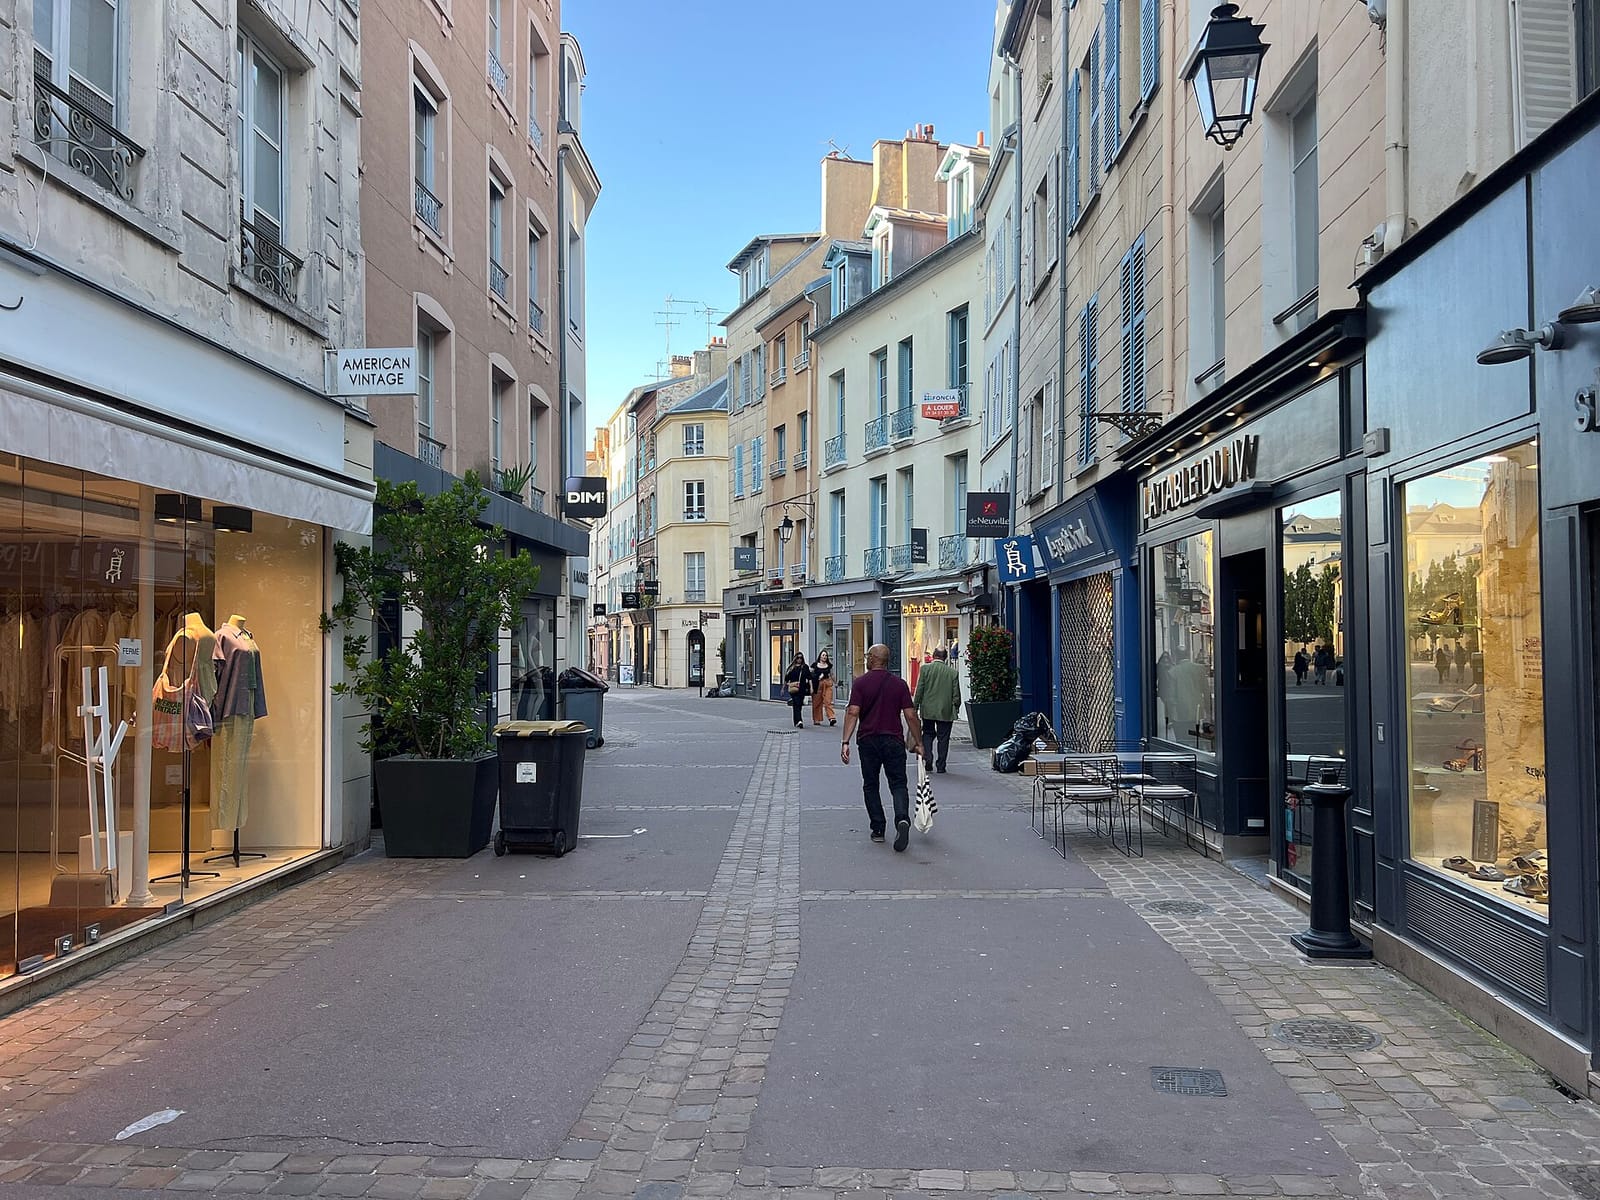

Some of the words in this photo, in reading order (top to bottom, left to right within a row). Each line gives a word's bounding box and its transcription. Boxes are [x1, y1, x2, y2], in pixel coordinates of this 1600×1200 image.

[342, 357, 410, 371] AMERICAN
[349, 373, 404, 386] VINTAGE
[567, 491, 601, 504] DIM
